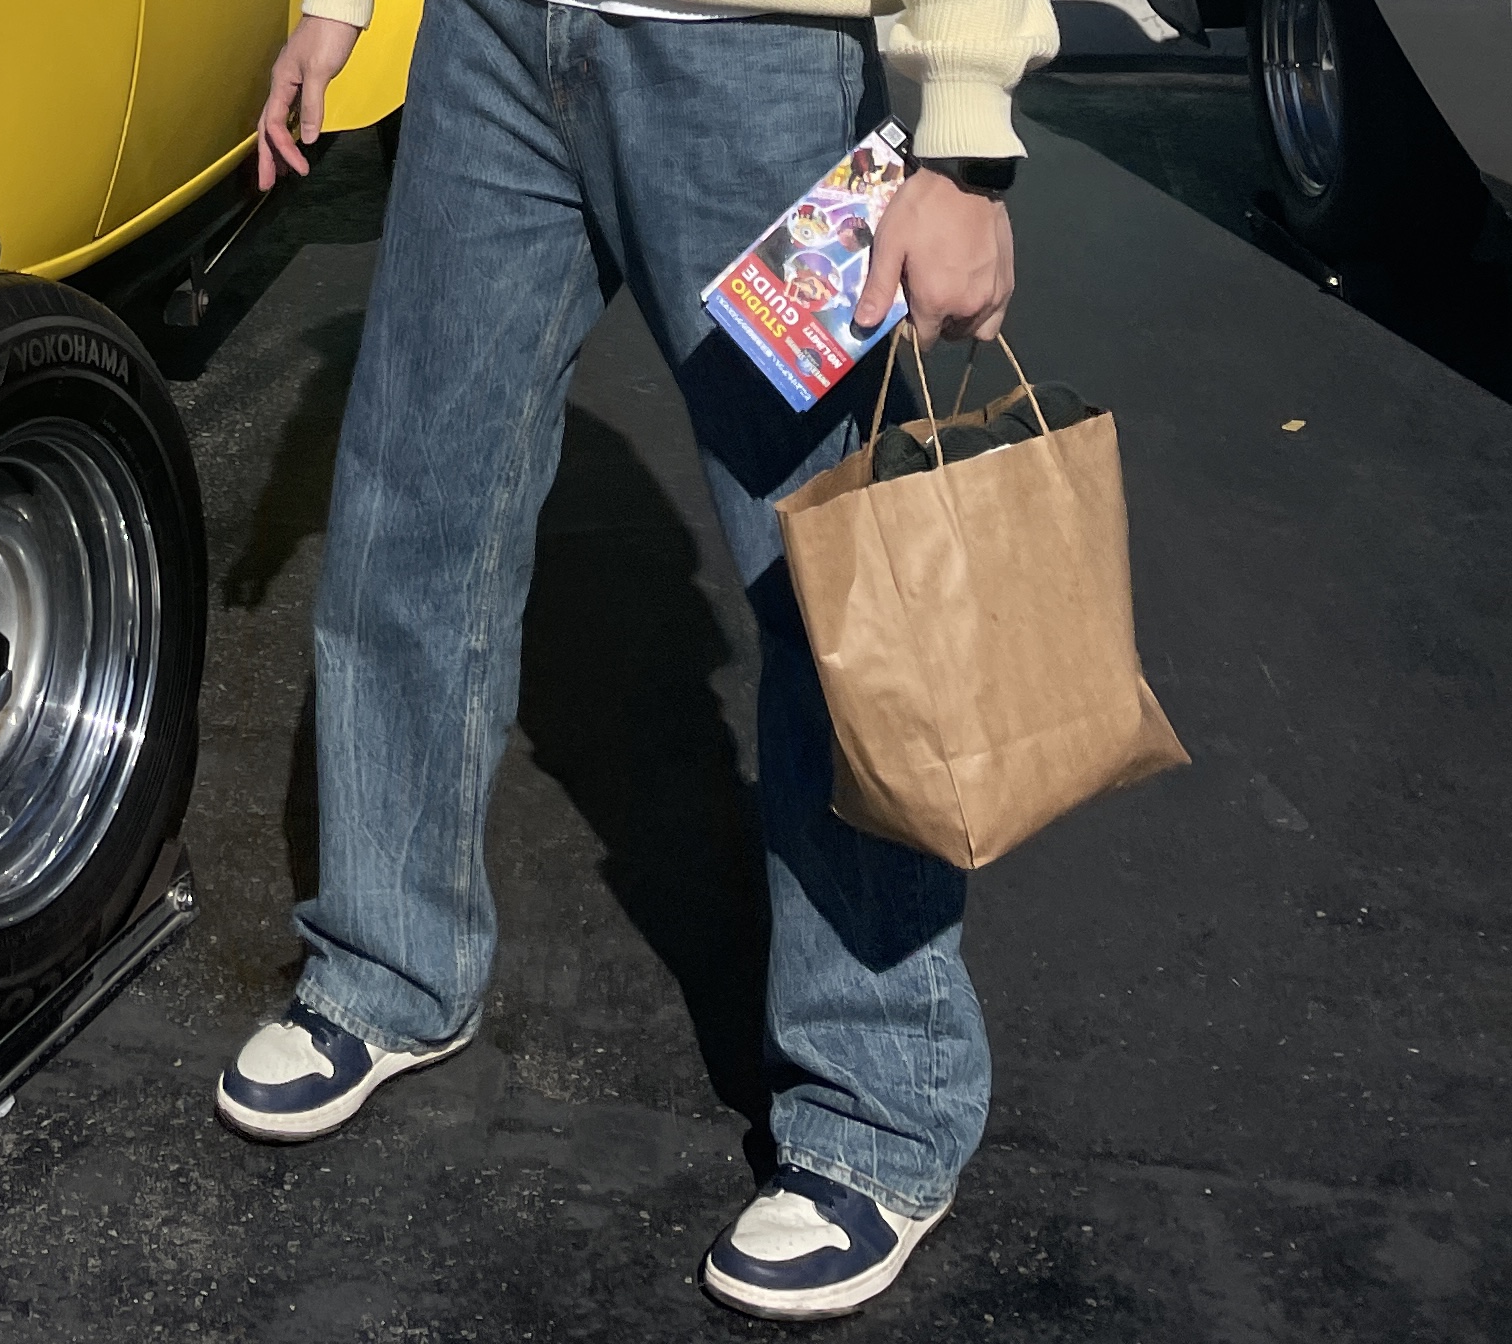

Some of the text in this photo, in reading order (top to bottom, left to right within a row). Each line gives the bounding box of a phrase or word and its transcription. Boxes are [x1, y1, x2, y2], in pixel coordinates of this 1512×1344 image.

[731, 278, 788, 338] STUDIO
[741, 263, 799, 326] GUIDE
[14, 334, 129, 385] YOKOHAMA
